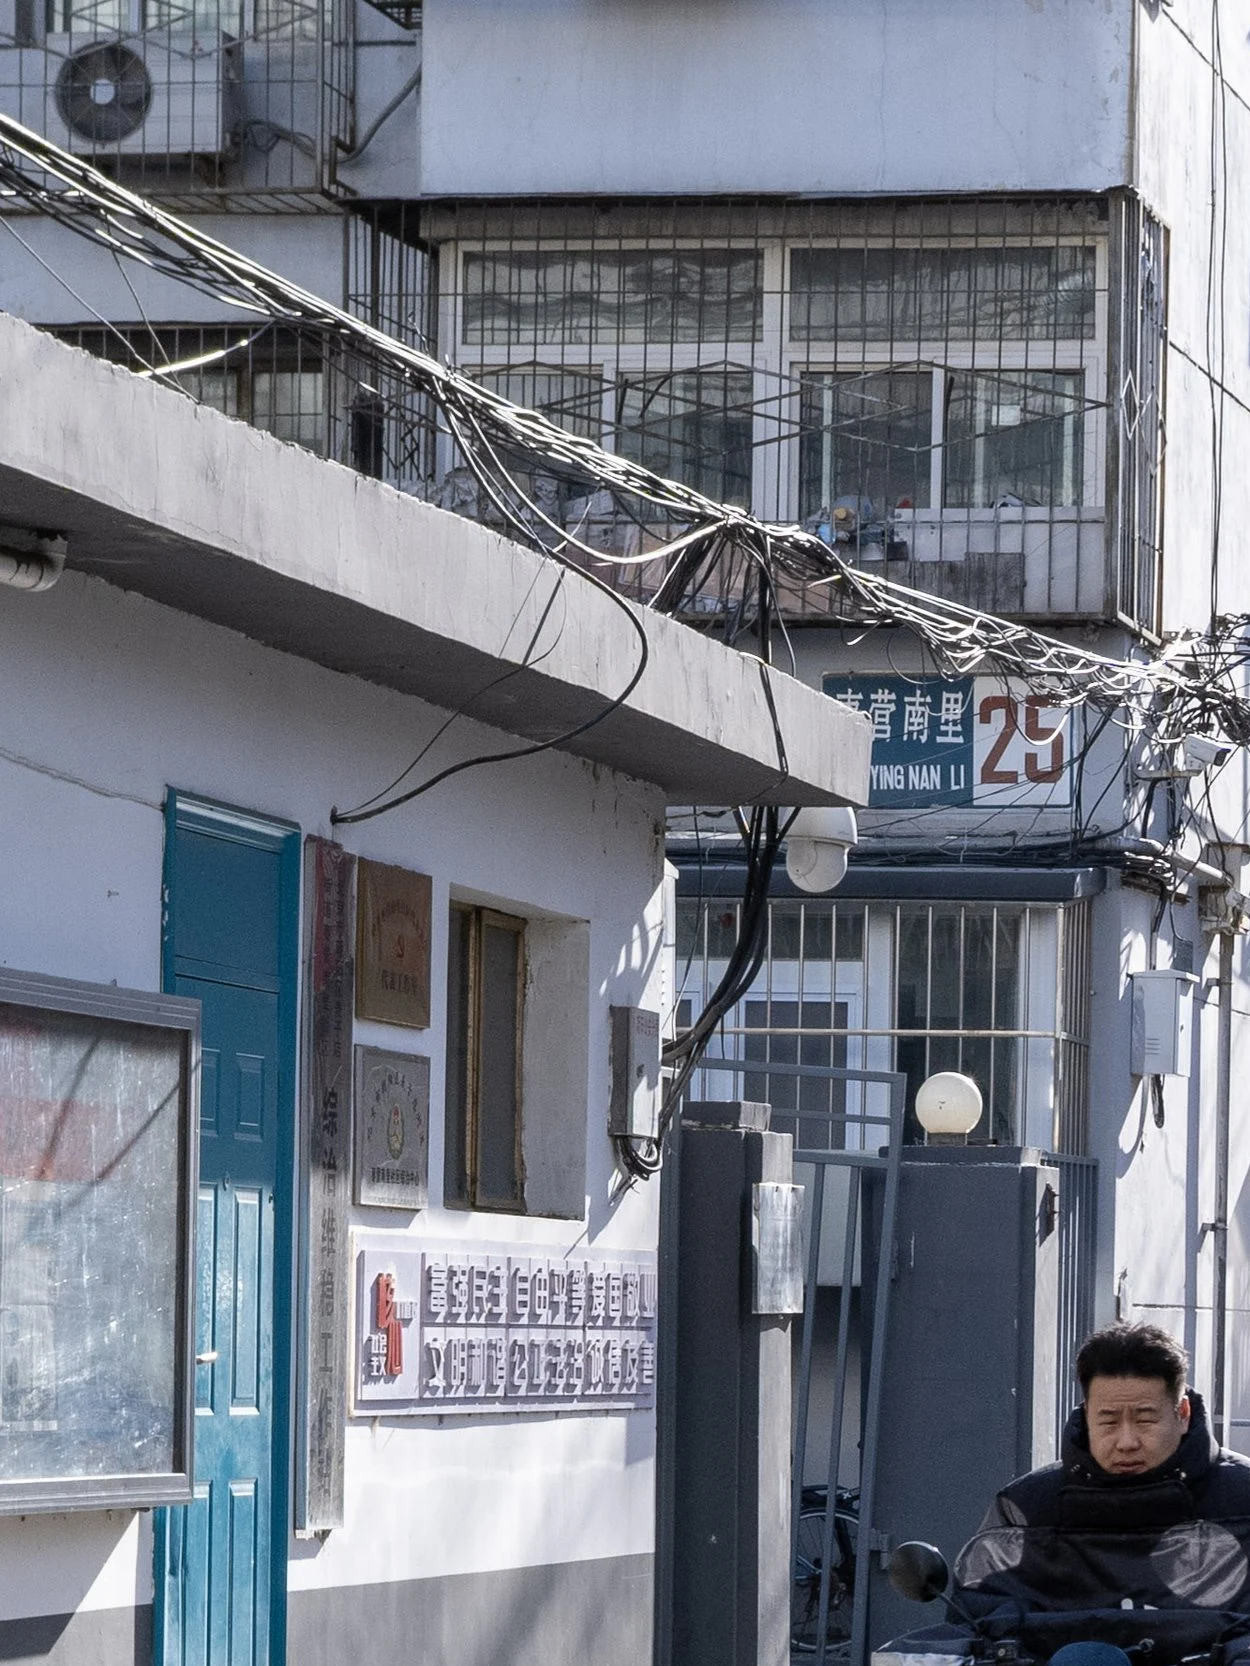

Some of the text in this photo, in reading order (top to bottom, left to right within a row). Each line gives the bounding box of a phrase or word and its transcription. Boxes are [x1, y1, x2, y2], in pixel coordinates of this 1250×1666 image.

[979, 695, 1065, 784] 25
[870, 764, 965, 790] YING NAN LI
